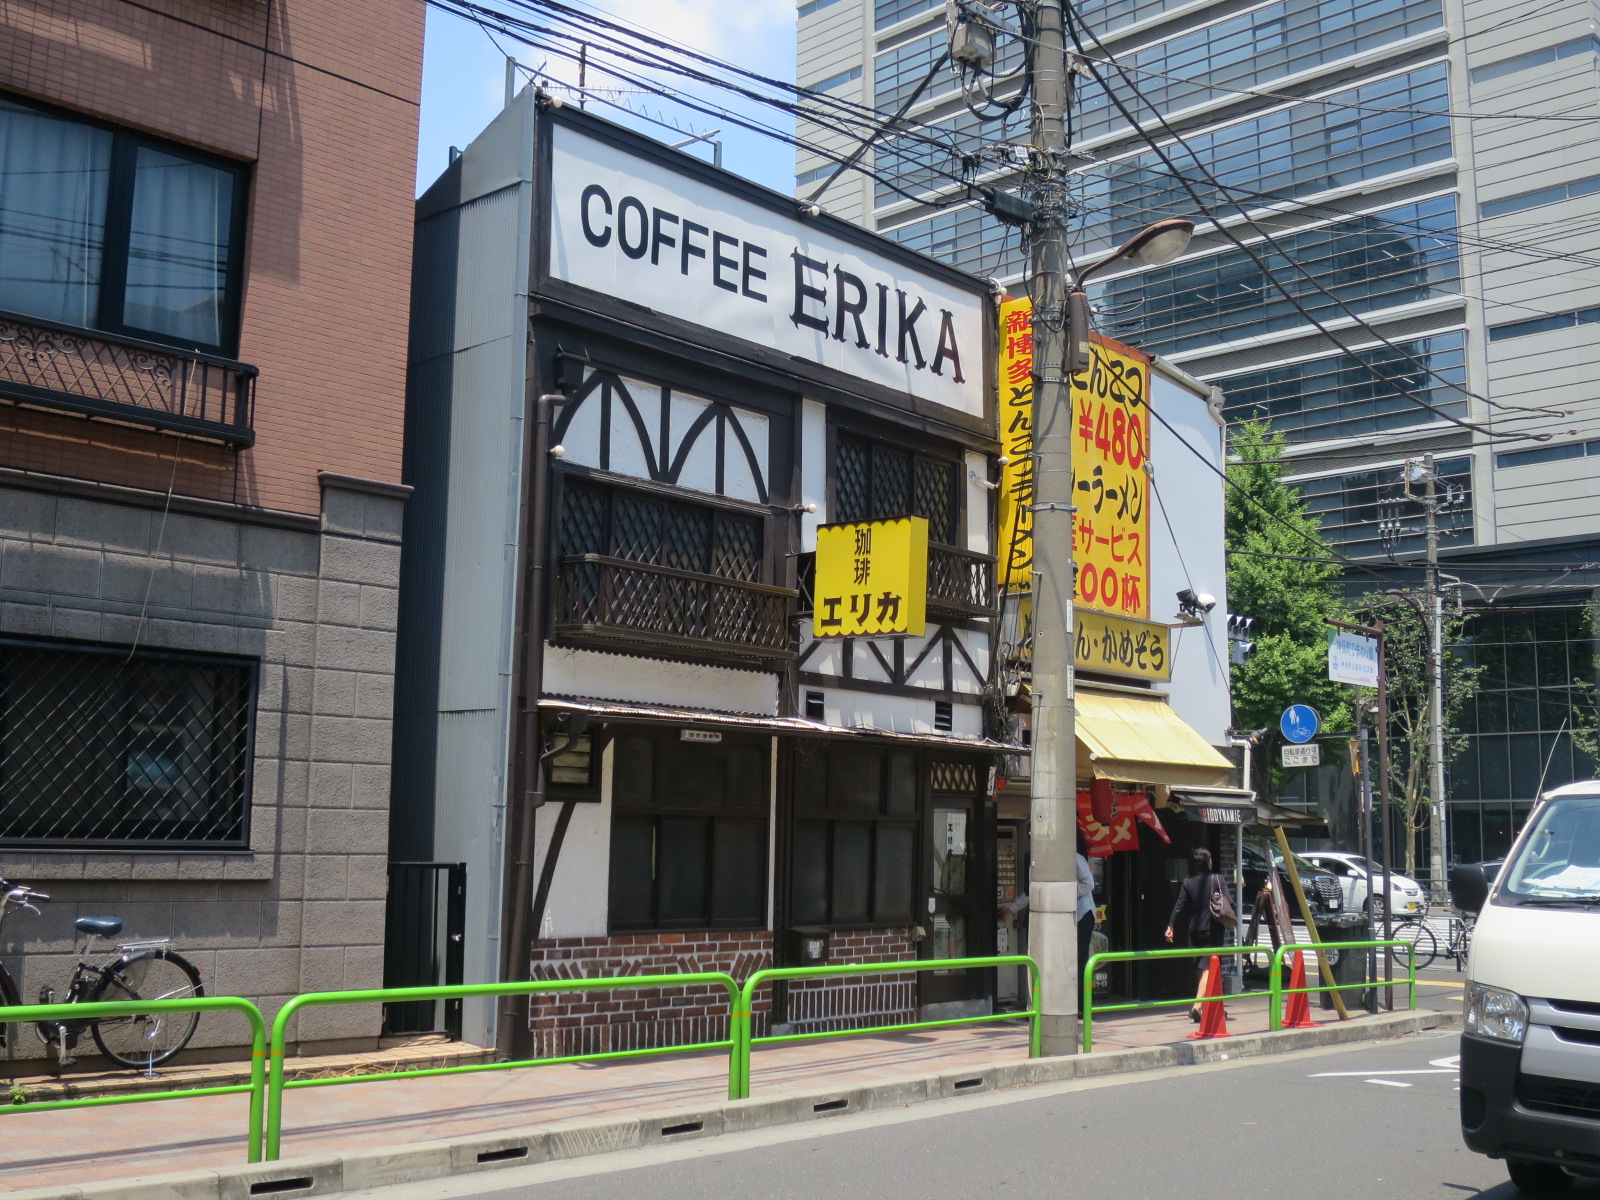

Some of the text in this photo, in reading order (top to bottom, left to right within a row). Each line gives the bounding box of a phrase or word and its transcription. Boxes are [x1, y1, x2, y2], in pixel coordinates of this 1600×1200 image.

[580, 184, 965, 384] COFFEE ERIKA
[1079, 397, 1142, 470] ¥480
[1071, 465, 1143, 524] ーラーメン
[853, 528, 871, 585] 珈琲
[820, 591, 902, 628] エリカ
[1073, 562, 1141, 614] 00杯
[1283, 746, 1317, 758] 自転車通行可
[1284, 756, 1317, 765] ここまで
